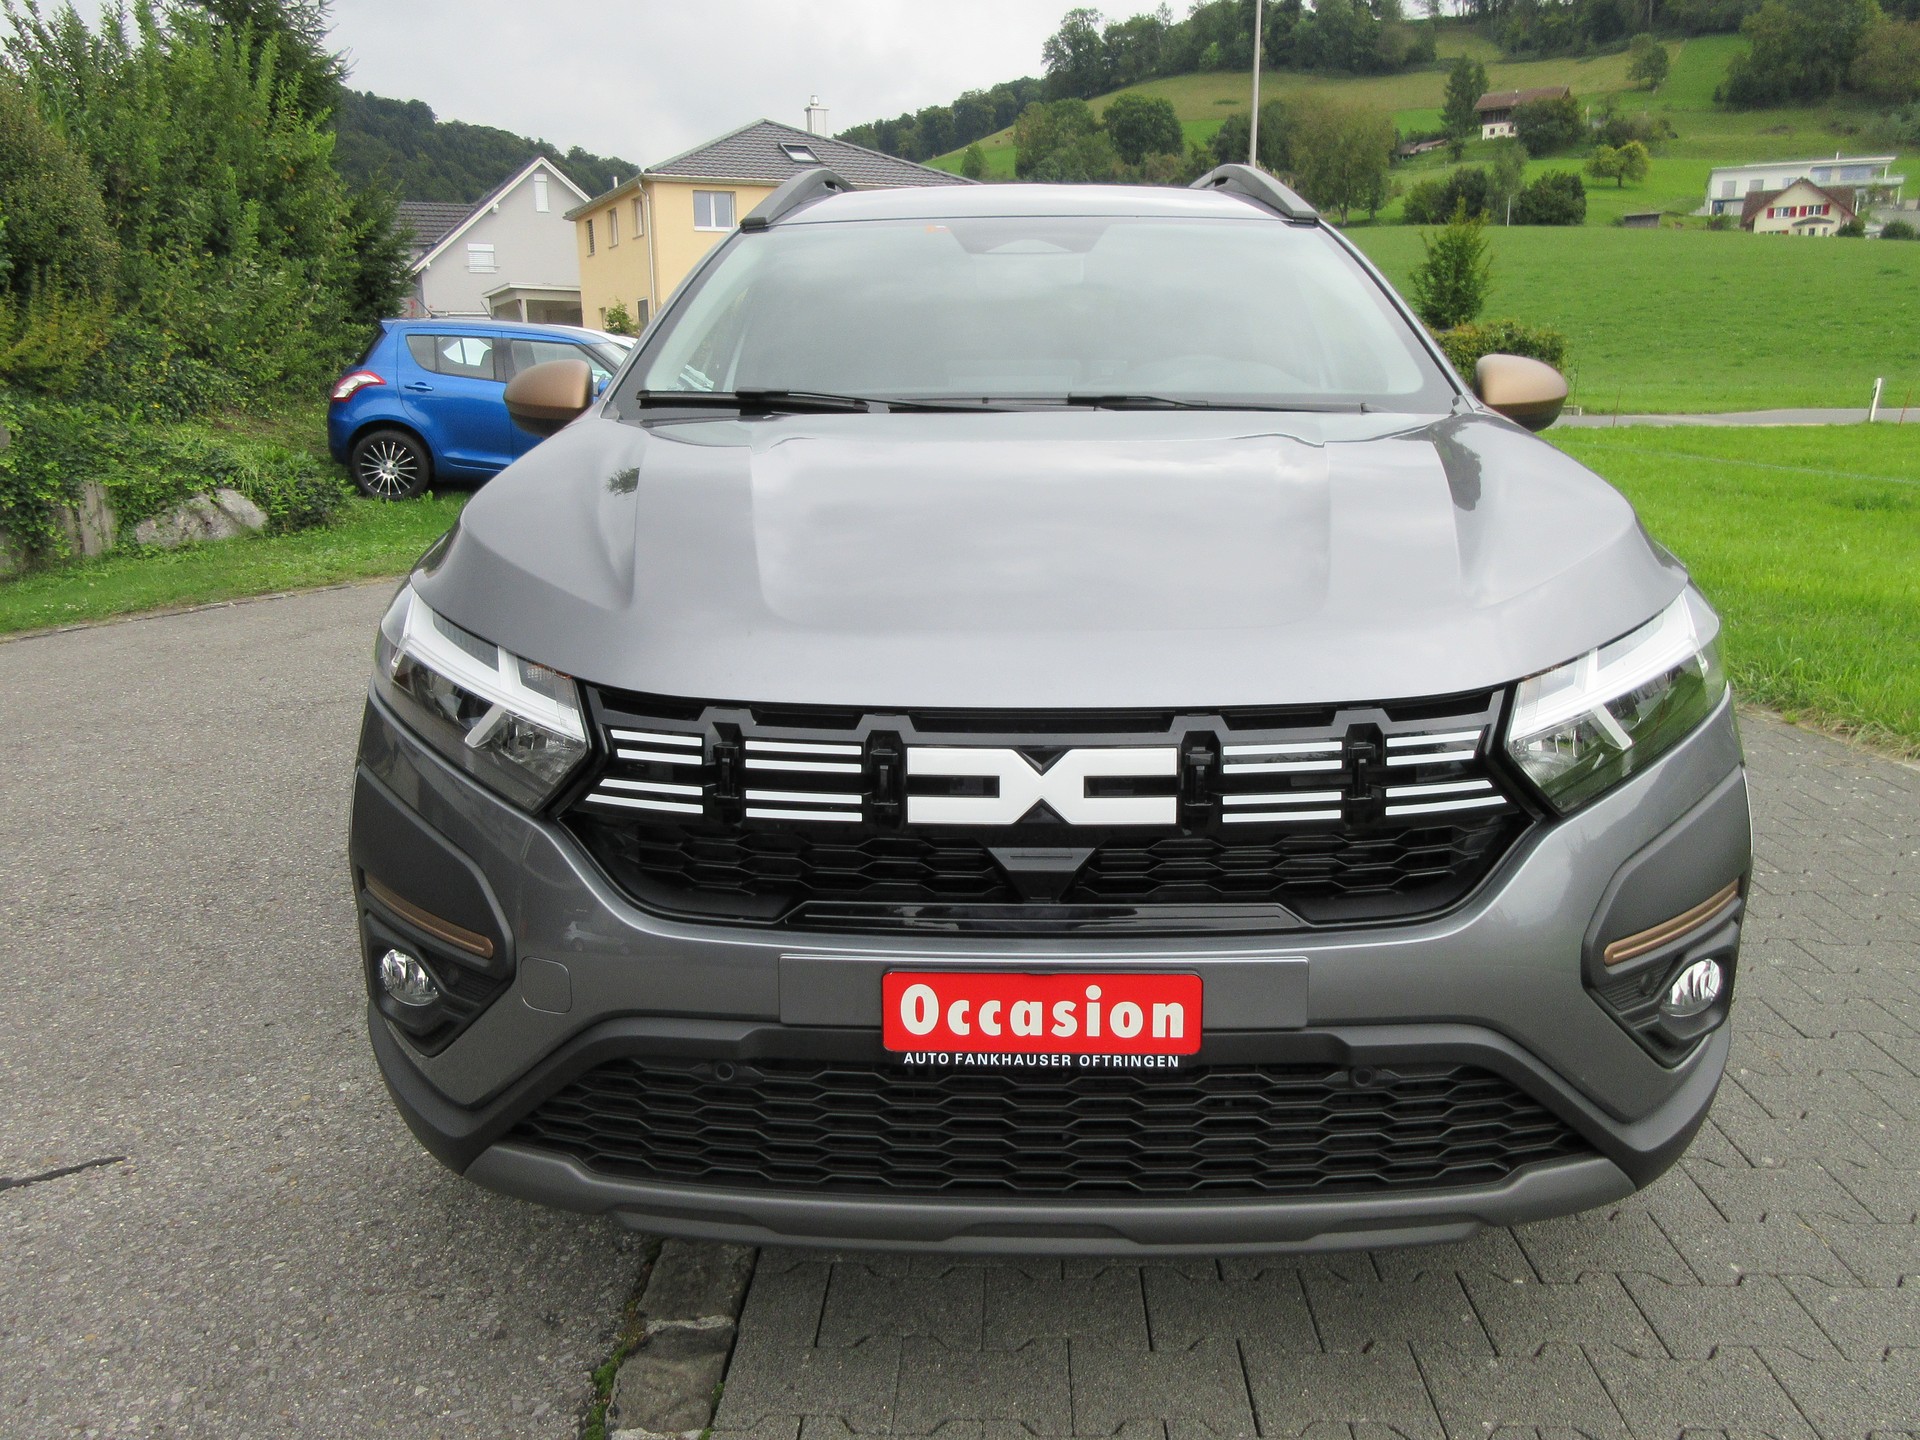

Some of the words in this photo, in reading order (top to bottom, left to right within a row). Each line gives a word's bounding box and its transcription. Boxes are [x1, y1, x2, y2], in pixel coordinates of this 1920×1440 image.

[901, 983, 1184, 1039] Occasion
[904, 1052, 949, 1066] AUTO
[955, 1052, 1071, 1067] FANKHAUSER
[1078, 1054, 1180, 1069] OFTRINGEN
